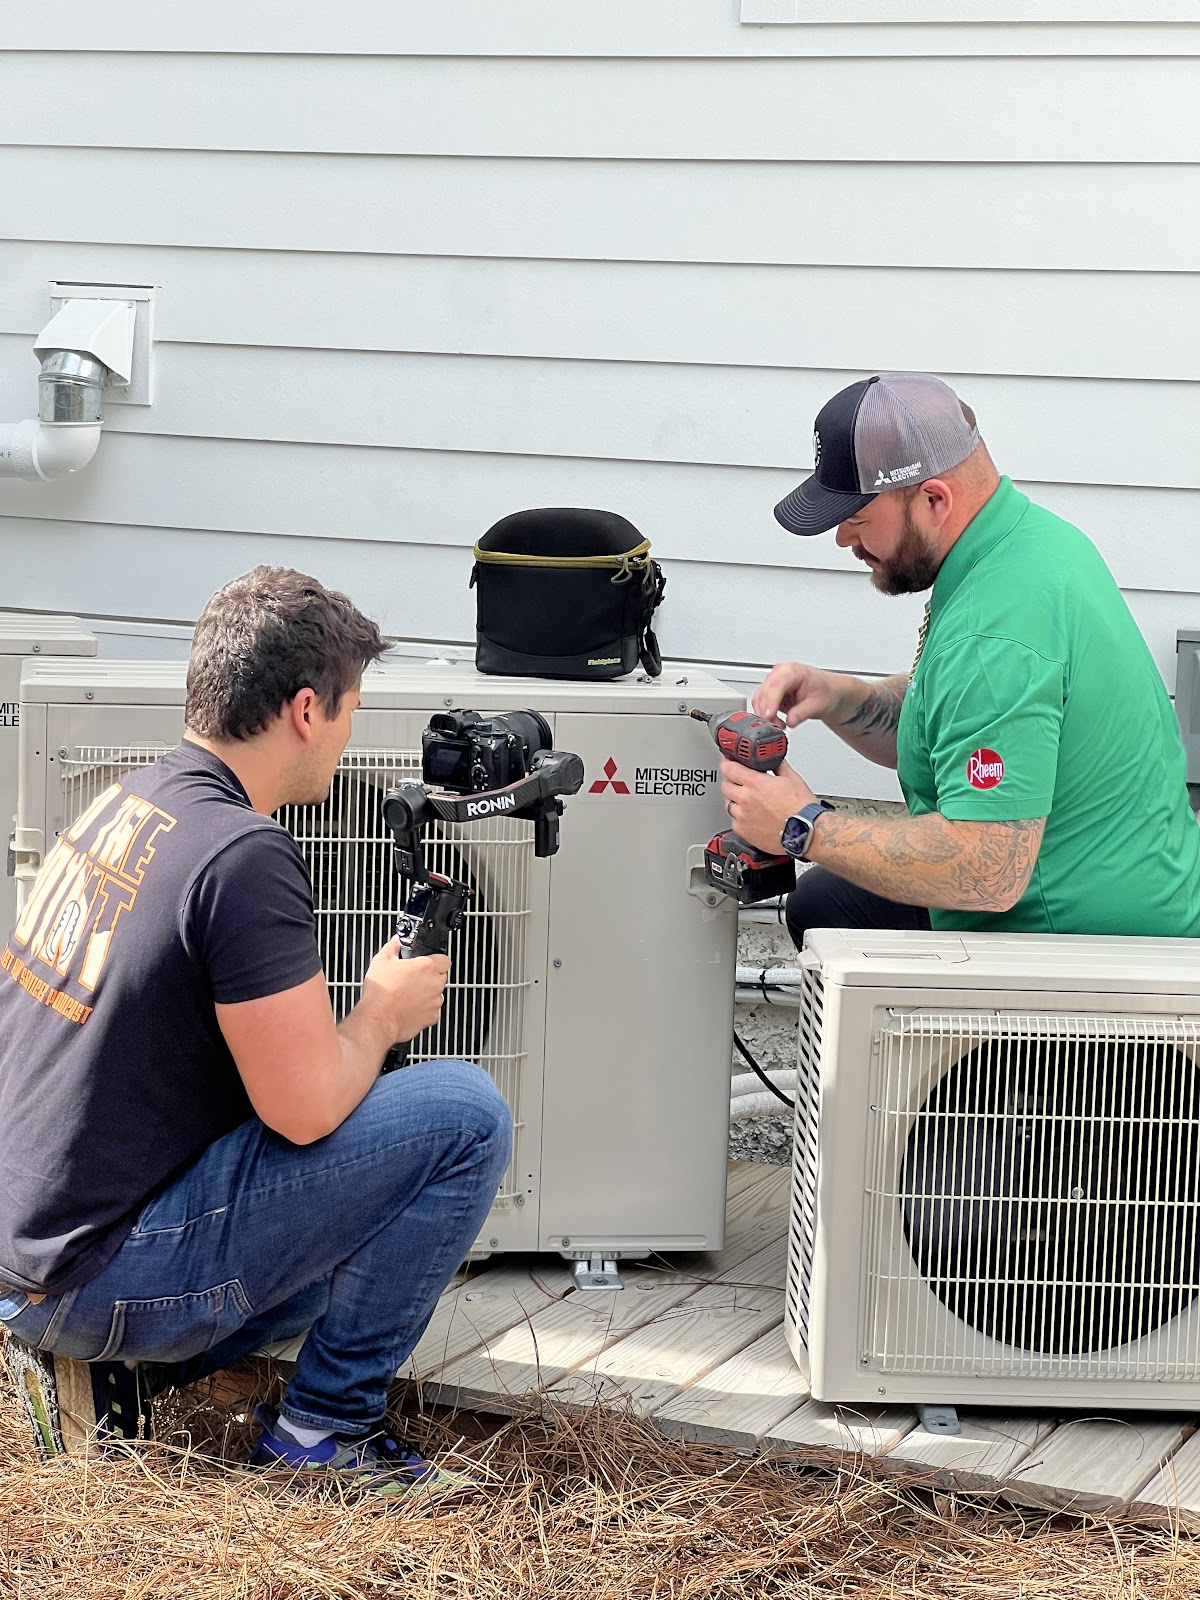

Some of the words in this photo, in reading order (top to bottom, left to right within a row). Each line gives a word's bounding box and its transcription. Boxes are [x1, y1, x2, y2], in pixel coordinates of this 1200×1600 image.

[891, 469, 921, 483] ELECTRIC
[635, 767, 718, 783] MITSUBISHI
[969, 748, 1003, 784] Rheem
[635, 781, 706, 797] ELECTRIC
[466, 792, 516, 817] RONIN
[44, 987, 94, 1025] PODCAST
